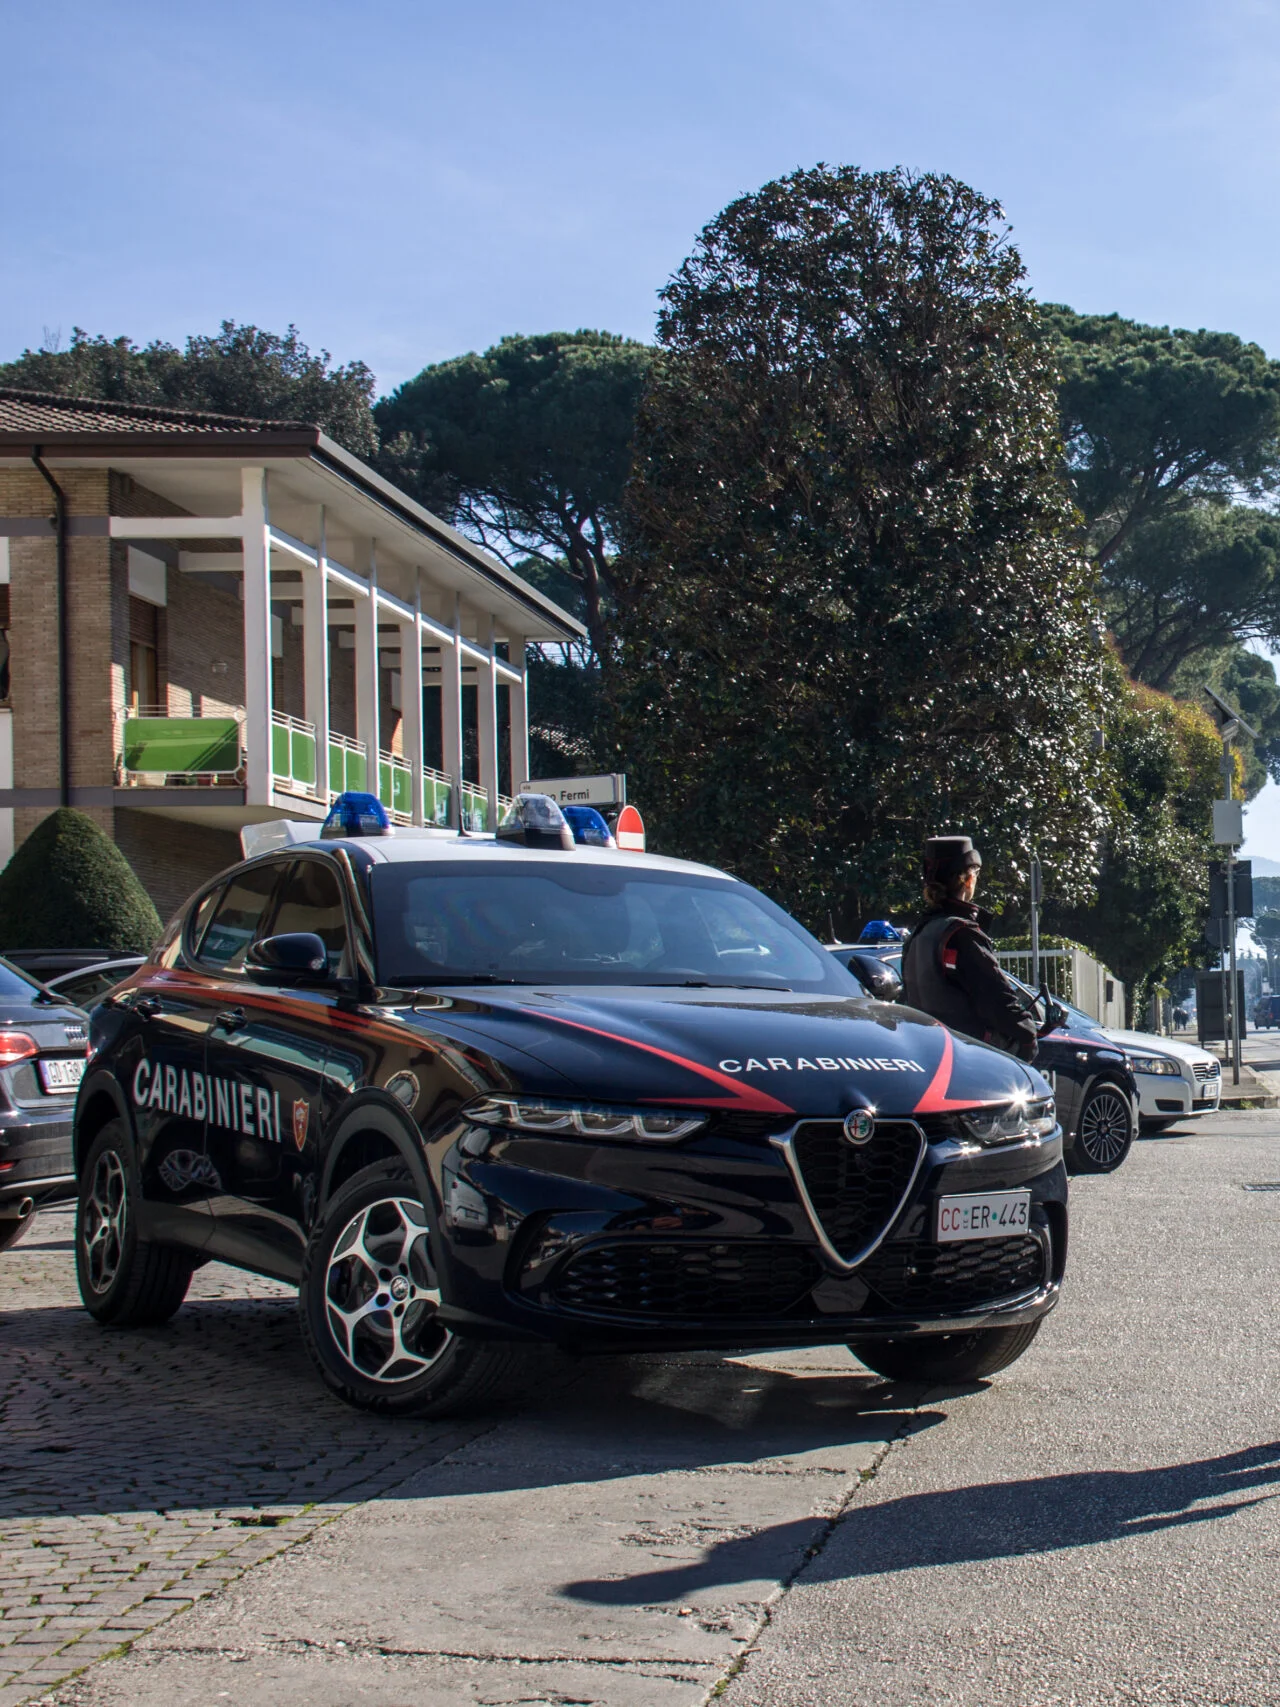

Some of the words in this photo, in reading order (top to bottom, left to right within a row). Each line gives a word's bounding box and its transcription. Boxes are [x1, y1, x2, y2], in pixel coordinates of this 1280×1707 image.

[560, 789, 590, 800] Fermi
[718, 1057, 926, 1073] CARABINIERI
[132, 1058, 281, 1143] CARABINIERI
[971, 1206, 990, 1229] ER
[999, 1202, 1027, 1227] 443
